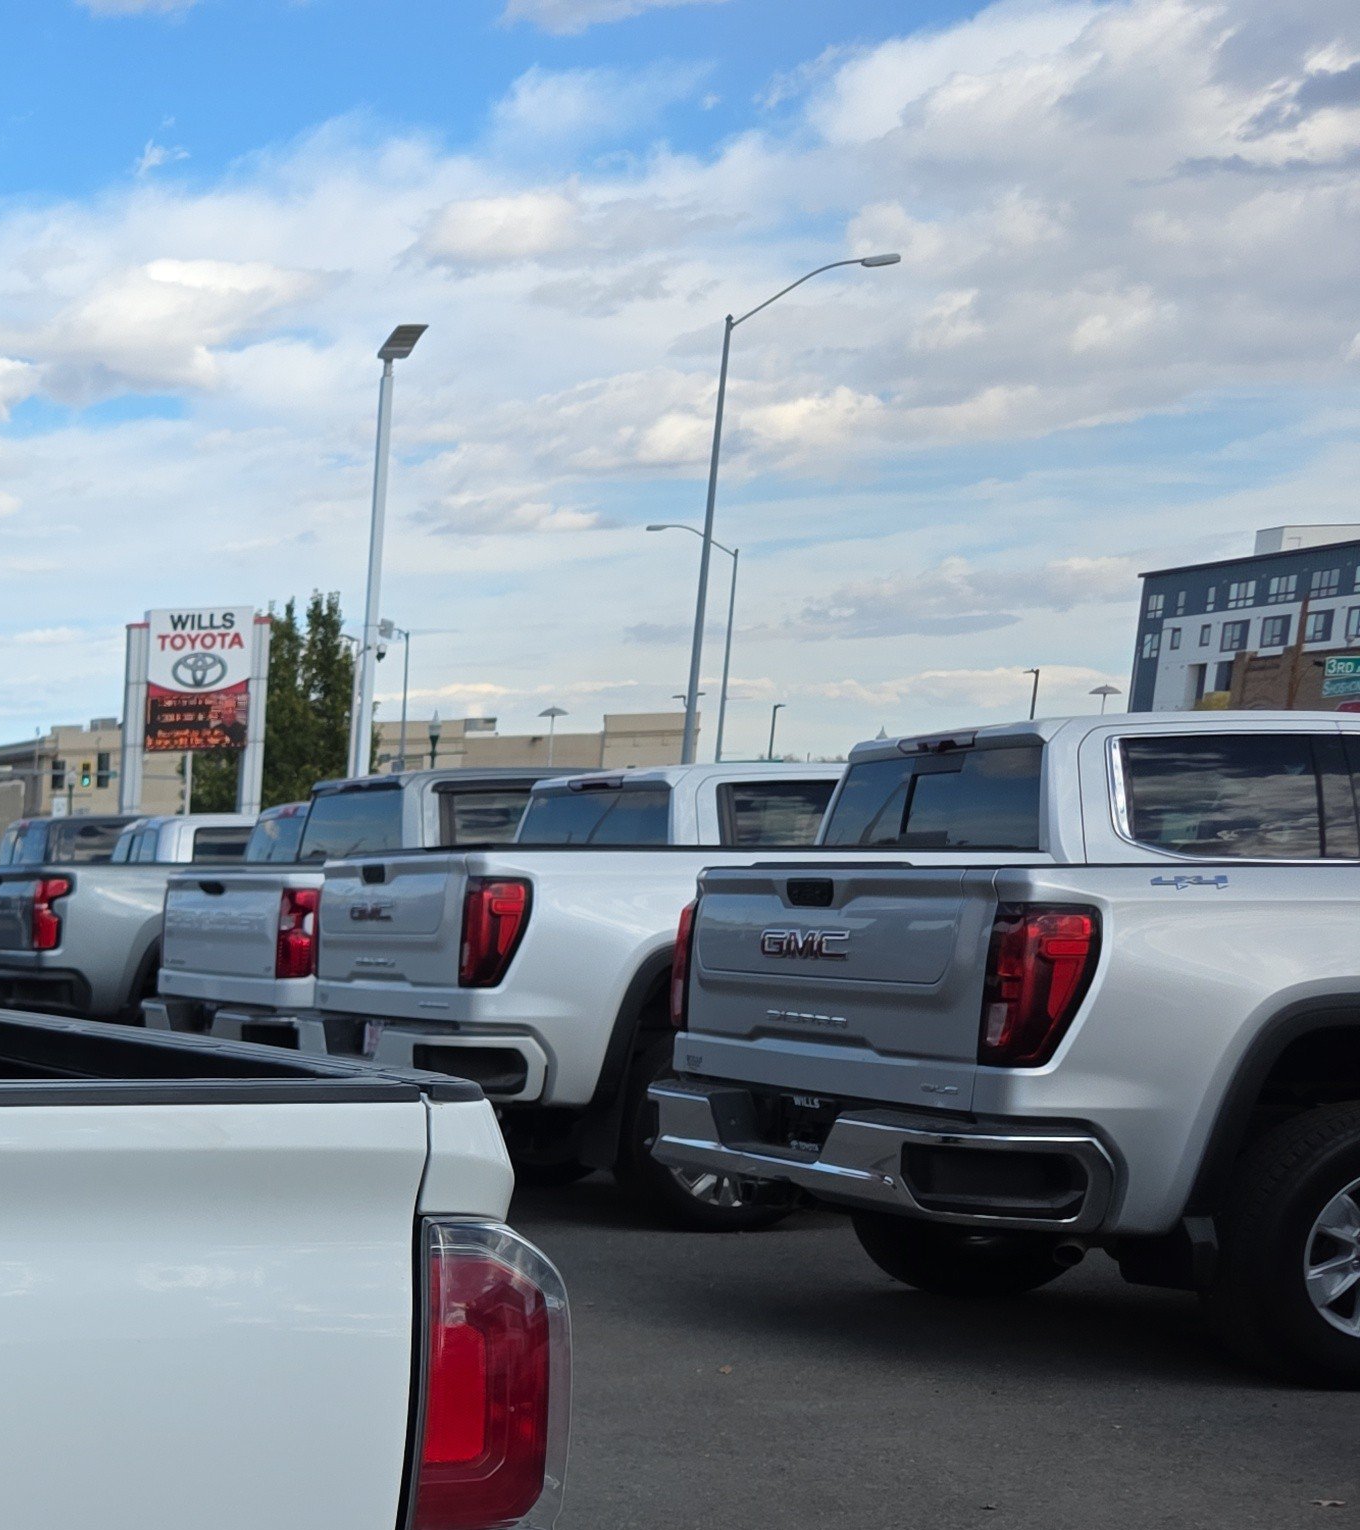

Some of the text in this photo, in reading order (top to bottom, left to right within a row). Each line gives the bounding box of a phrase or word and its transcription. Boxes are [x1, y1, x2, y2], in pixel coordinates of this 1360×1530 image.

[170, 612, 235, 631] WILLS
[157, 632, 244, 651] TOYOTA
[1327, 659, 1354, 674] 3RD
[760, 928, 850, 960] GMC
[793, 1095, 820, 1109] WILLS
